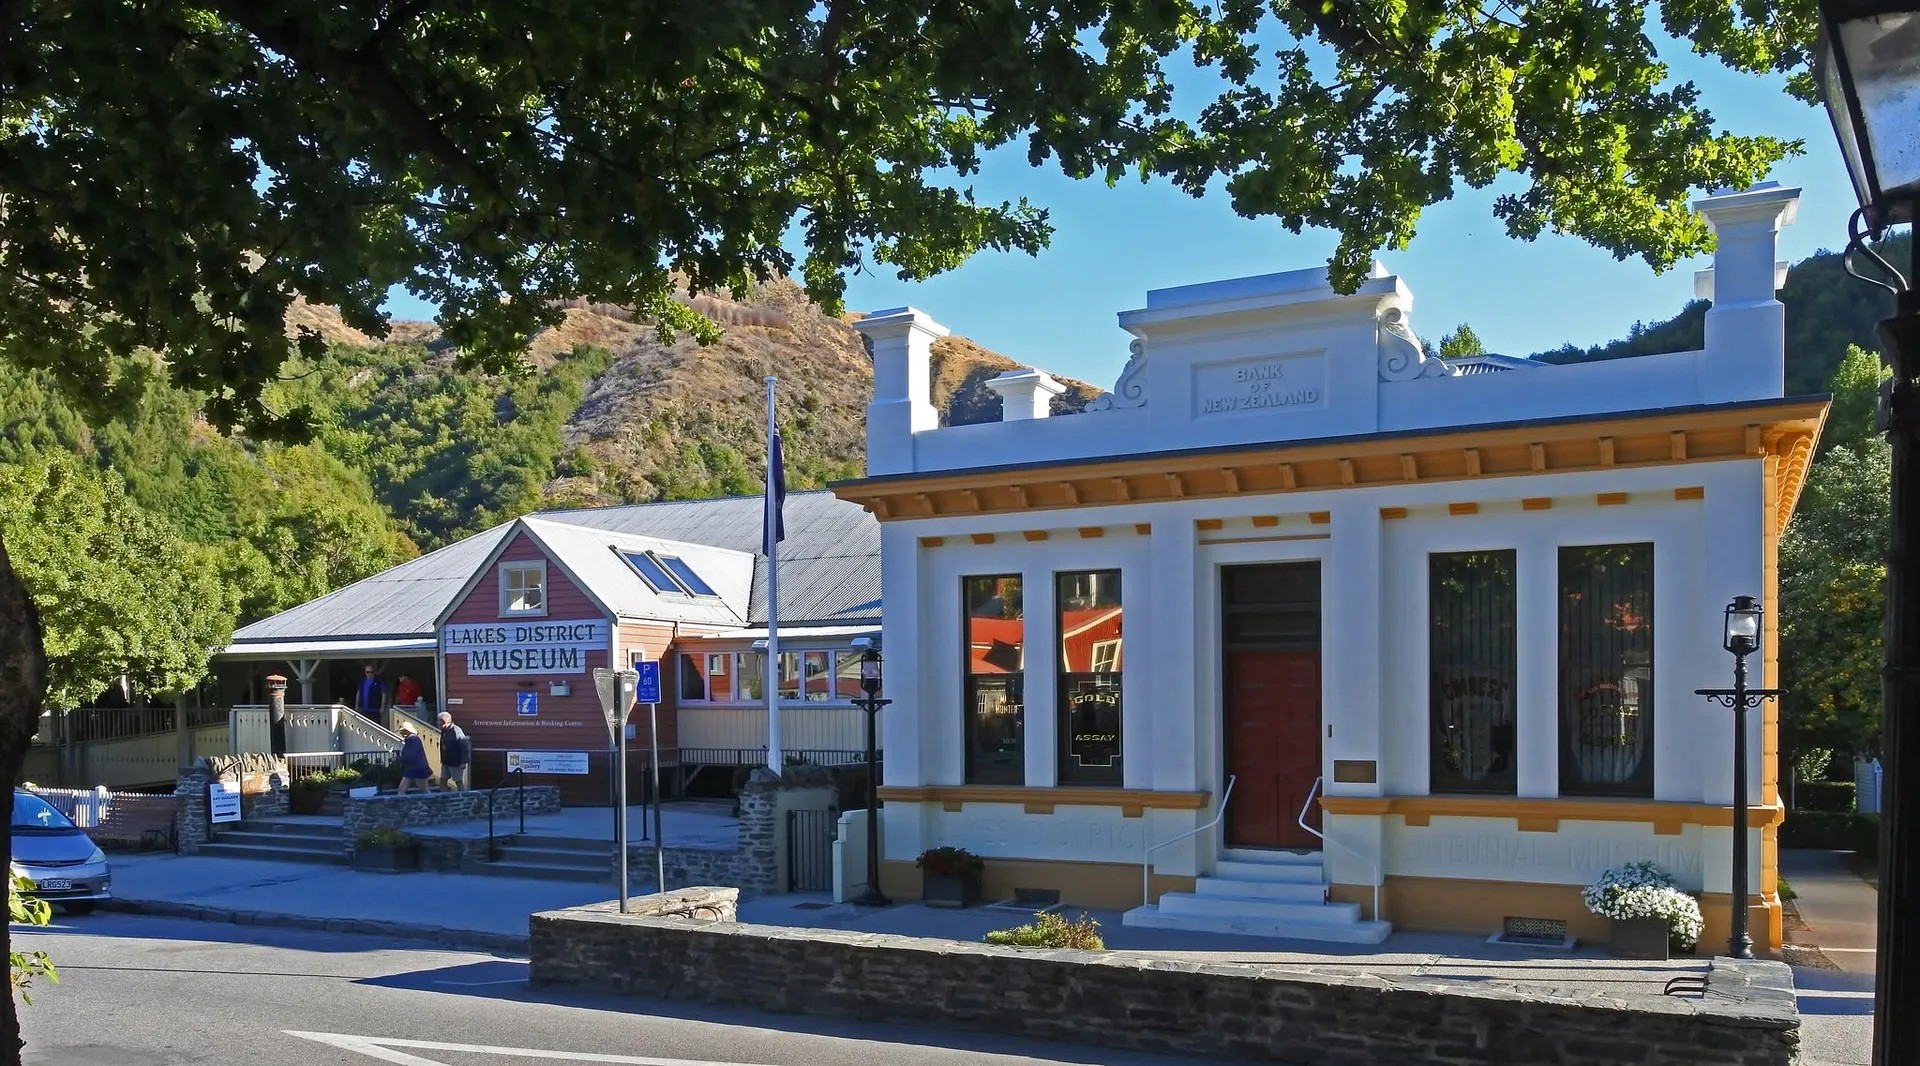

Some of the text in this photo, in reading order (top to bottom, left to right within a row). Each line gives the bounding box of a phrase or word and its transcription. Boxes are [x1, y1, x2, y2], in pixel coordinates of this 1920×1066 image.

[1236, 364, 1284, 383] BANK
[1250, 382, 1271, 394] OF
[1203, 389, 1319, 414] NEW ZEALAND
[451, 624, 597, 645] LAKES DISTRICT
[471, 647, 579, 671] MUSEUM
[643, 664, 651, 675] P
[643, 677, 652, 686] 60
[1073, 693, 1117, 705] GOLD
[1075, 734, 1116, 742] ASSAY
